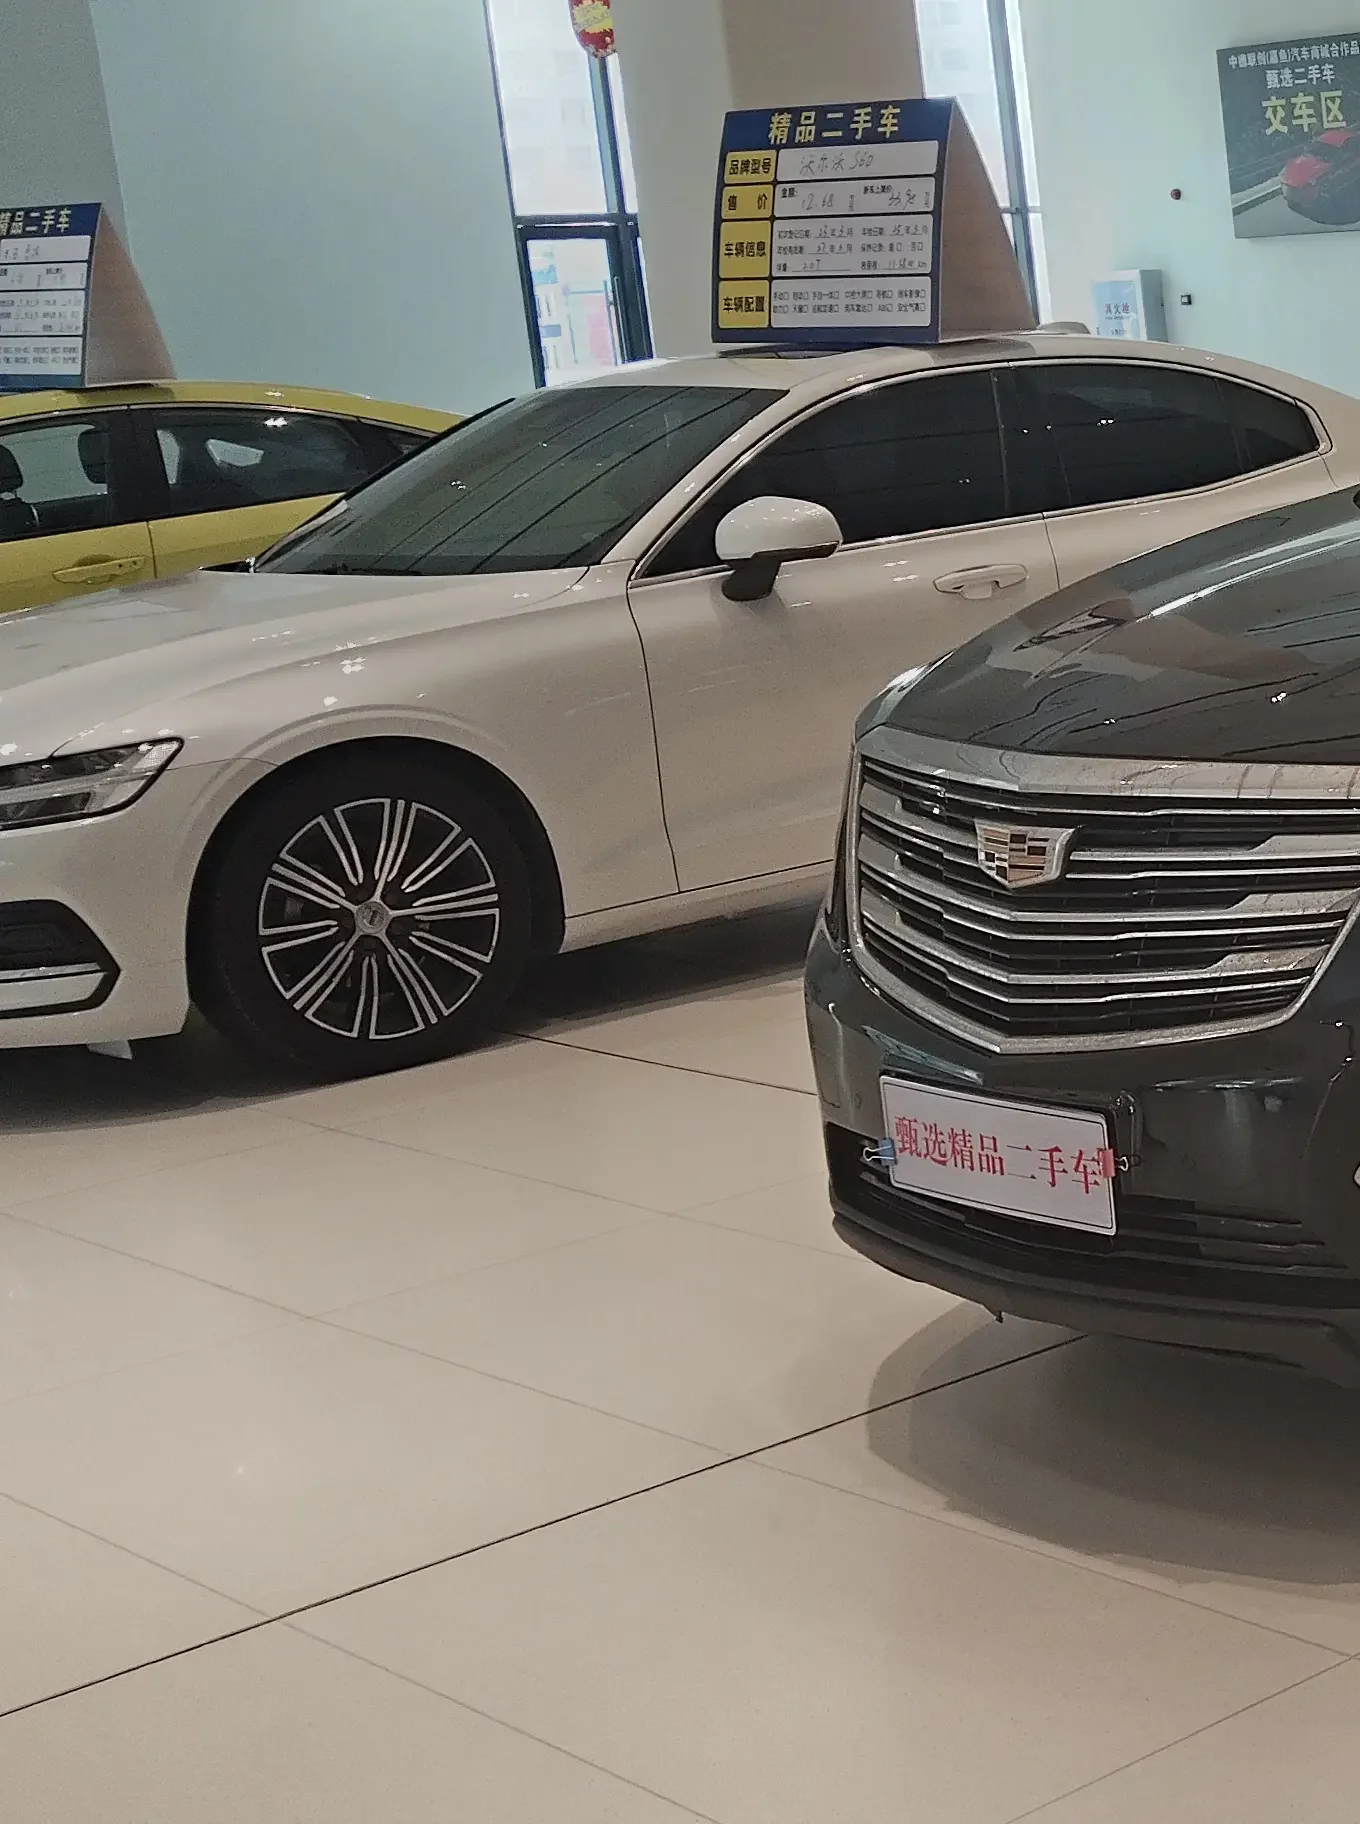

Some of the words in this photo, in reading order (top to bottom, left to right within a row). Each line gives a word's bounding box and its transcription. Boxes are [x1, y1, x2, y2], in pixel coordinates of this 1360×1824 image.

[1265, 63, 1336, 89] 甄选二手车
[1261, 90, 1347, 136] 交车区
[768, 104, 901, 145] 精品二手车
[729, 158, 771, 175] 品牌型号
[727, 194, 737, 211] 售
[757, 193, 768, 210] 价
[724, 241, 766, 258] 车辆信息
[723, 296, 765, 313] 车辆配置
[894, 1116, 1101, 1195] 甄选精品二手车
